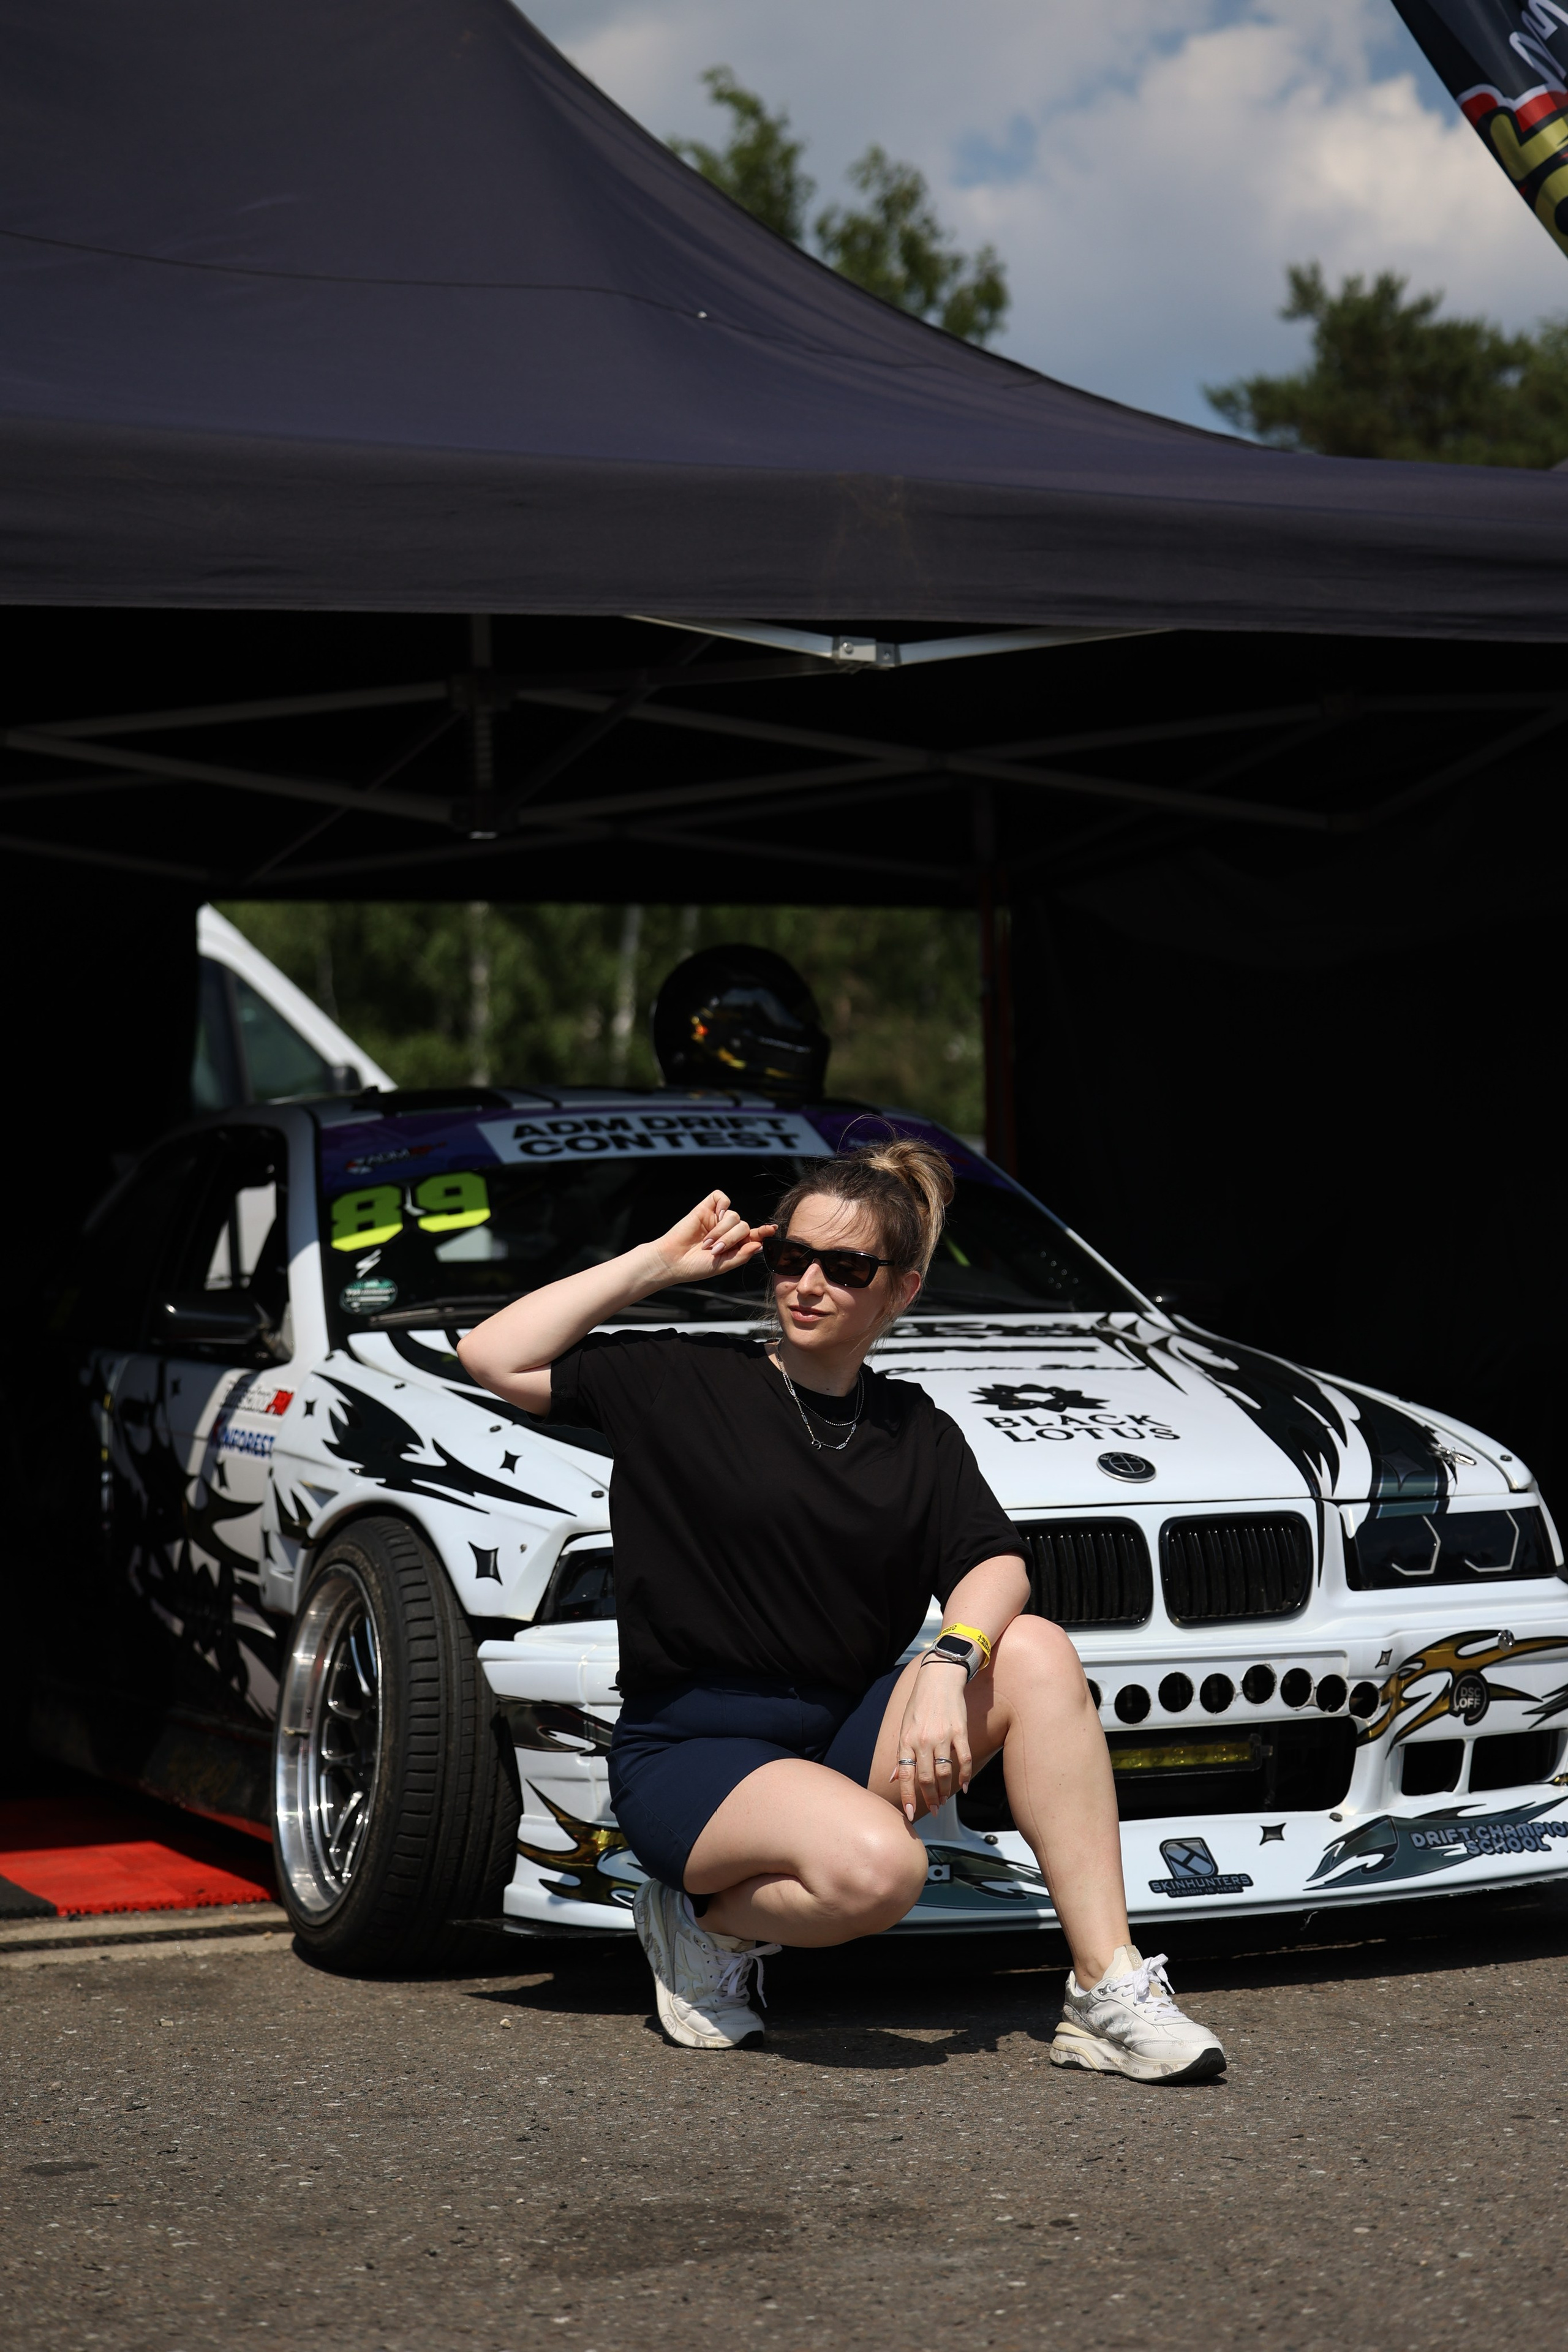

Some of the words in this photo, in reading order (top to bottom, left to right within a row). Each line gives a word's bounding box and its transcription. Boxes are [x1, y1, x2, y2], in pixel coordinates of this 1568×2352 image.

[513, 1117, 632, 1140] ADM
[639, 1115, 788, 1131] DRIFT
[519, 1132, 801, 1156] CONTEST
[331, 1171, 491, 1252] 89
[982, 1414, 1172, 1428] BLACK
[1001, 1427, 1181, 1442] LOTUS
[1460, 1686, 1481, 1697] DSC
[1459, 1697, 1481, 1708] OFF
[1411, 1828, 1470, 1847] DRIFT
[1475, 1822, 1568, 1840] CHAMPIO
[1466, 1836, 1551, 1855] SCHOOL
[1152, 1875, 1250, 1891] SKINHUNTERS
